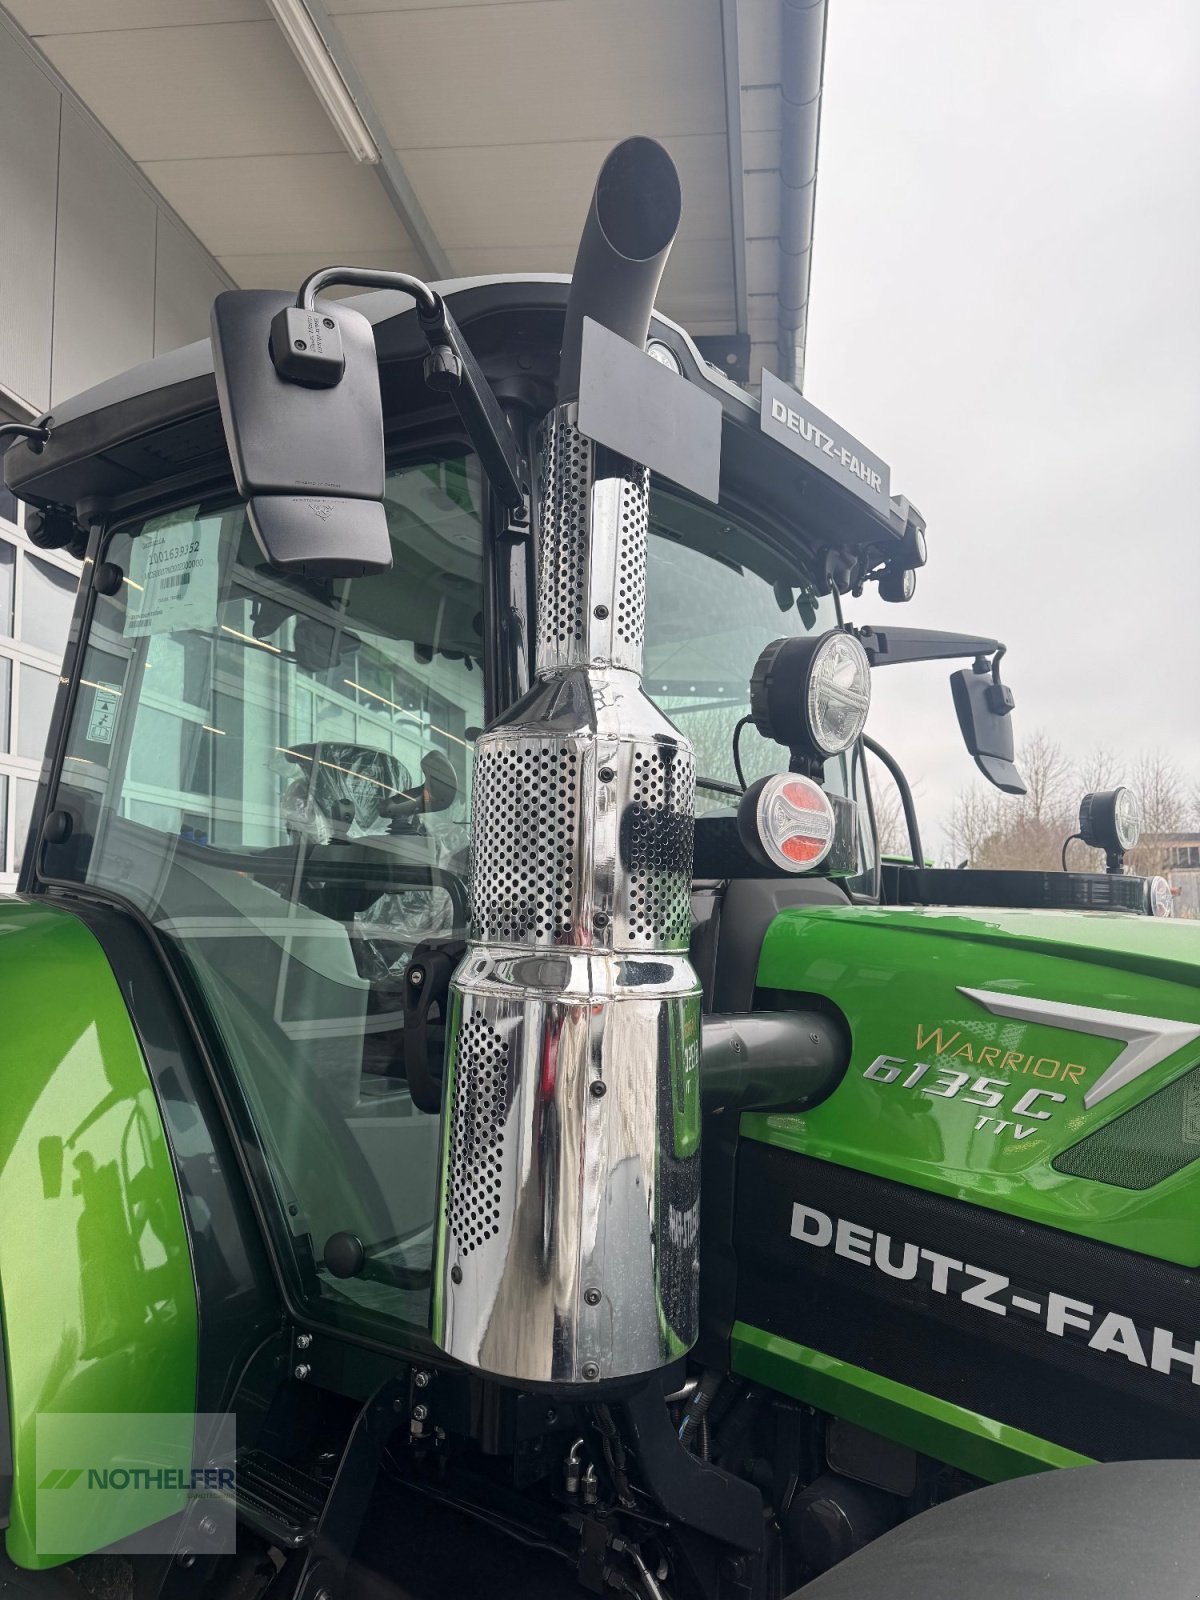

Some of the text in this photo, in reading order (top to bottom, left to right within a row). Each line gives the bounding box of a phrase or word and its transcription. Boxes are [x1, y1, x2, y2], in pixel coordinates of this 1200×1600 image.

[771, 397, 882, 493] DEUTZ-FAHR
[916, 1023, 1087, 1085] WARRIOR
[863, 1054, 1068, 1120] 6135 C
[974, 1115, 1038, 1140] TTV
